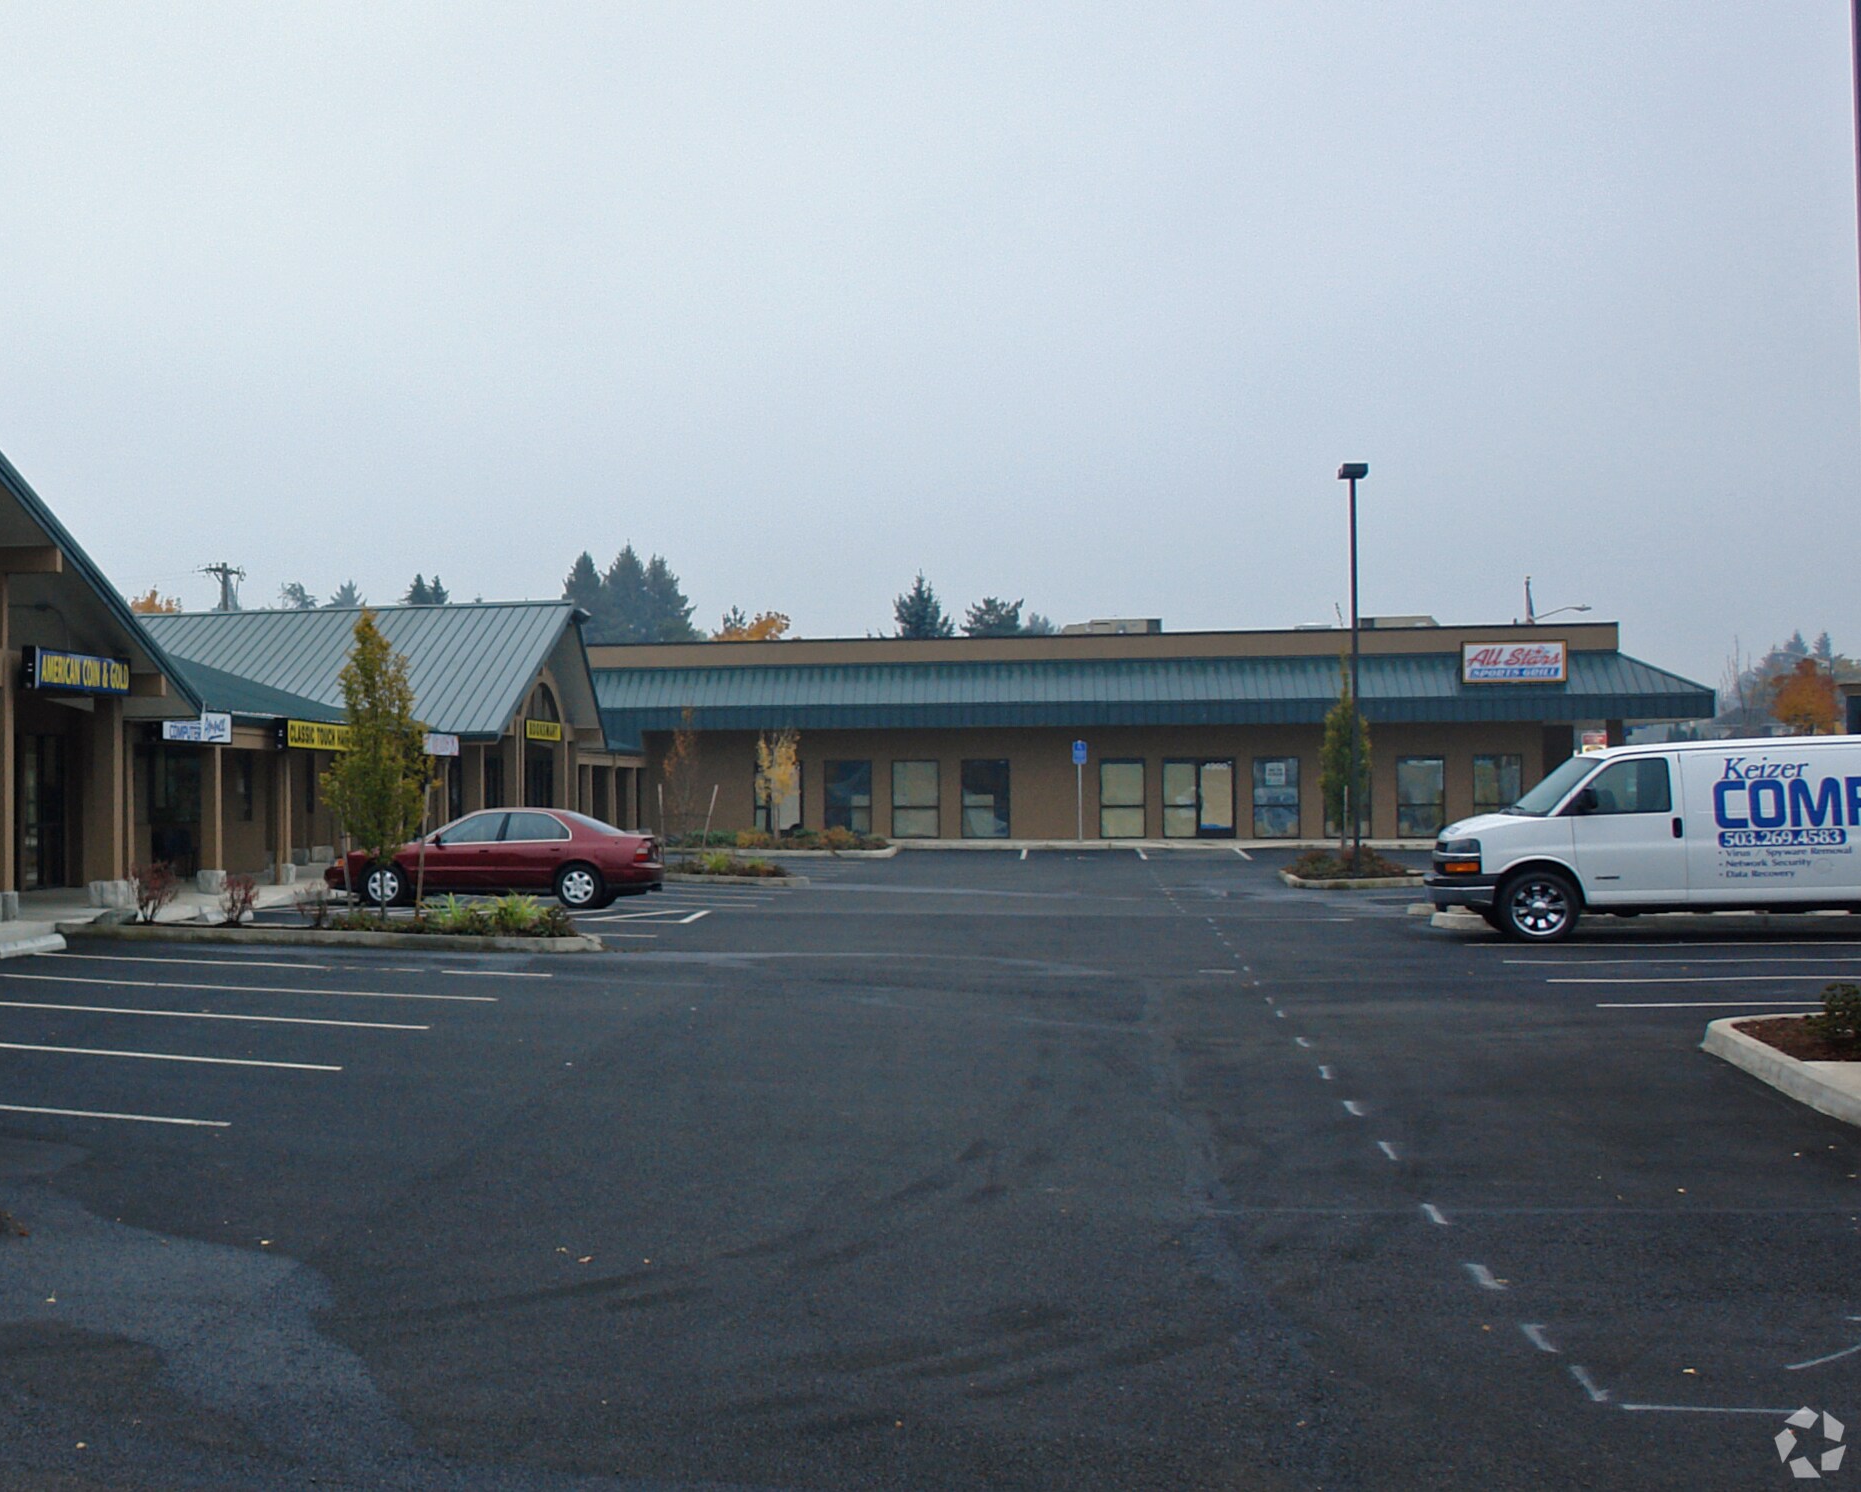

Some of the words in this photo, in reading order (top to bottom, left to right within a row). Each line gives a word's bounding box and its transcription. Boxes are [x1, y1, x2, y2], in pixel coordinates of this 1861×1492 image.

[1467, 648, 1503, 667] All
[1504, 648, 1560, 666] Stars
[41, 655, 81, 685] AMERICAN
[83, 659, 100, 687] COIN
[102, 662, 109, 688] &
[110, 663, 129, 689] GOLD
[1472, 669, 1520, 679] SPORTS
[1522, 668, 1558, 678] GRILL
[290, 724, 314, 744] CLASSIC
[317, 727, 335, 746] TOUCH
[1721, 757, 1809, 780] Keizer
[1723, 829, 1841, 848] 503.269.4583
[1725, 850, 1751, 858] Virus
[1765, 848, 1806, 858] Spyware
[1810, 846, 1852, 855] Removal
[1725, 860, 1767, 868] Network
[1772, 858, 1812, 867] Security
[1725, 870, 1748, 878] Data
[1751, 869, 1795, 878] Recovery
